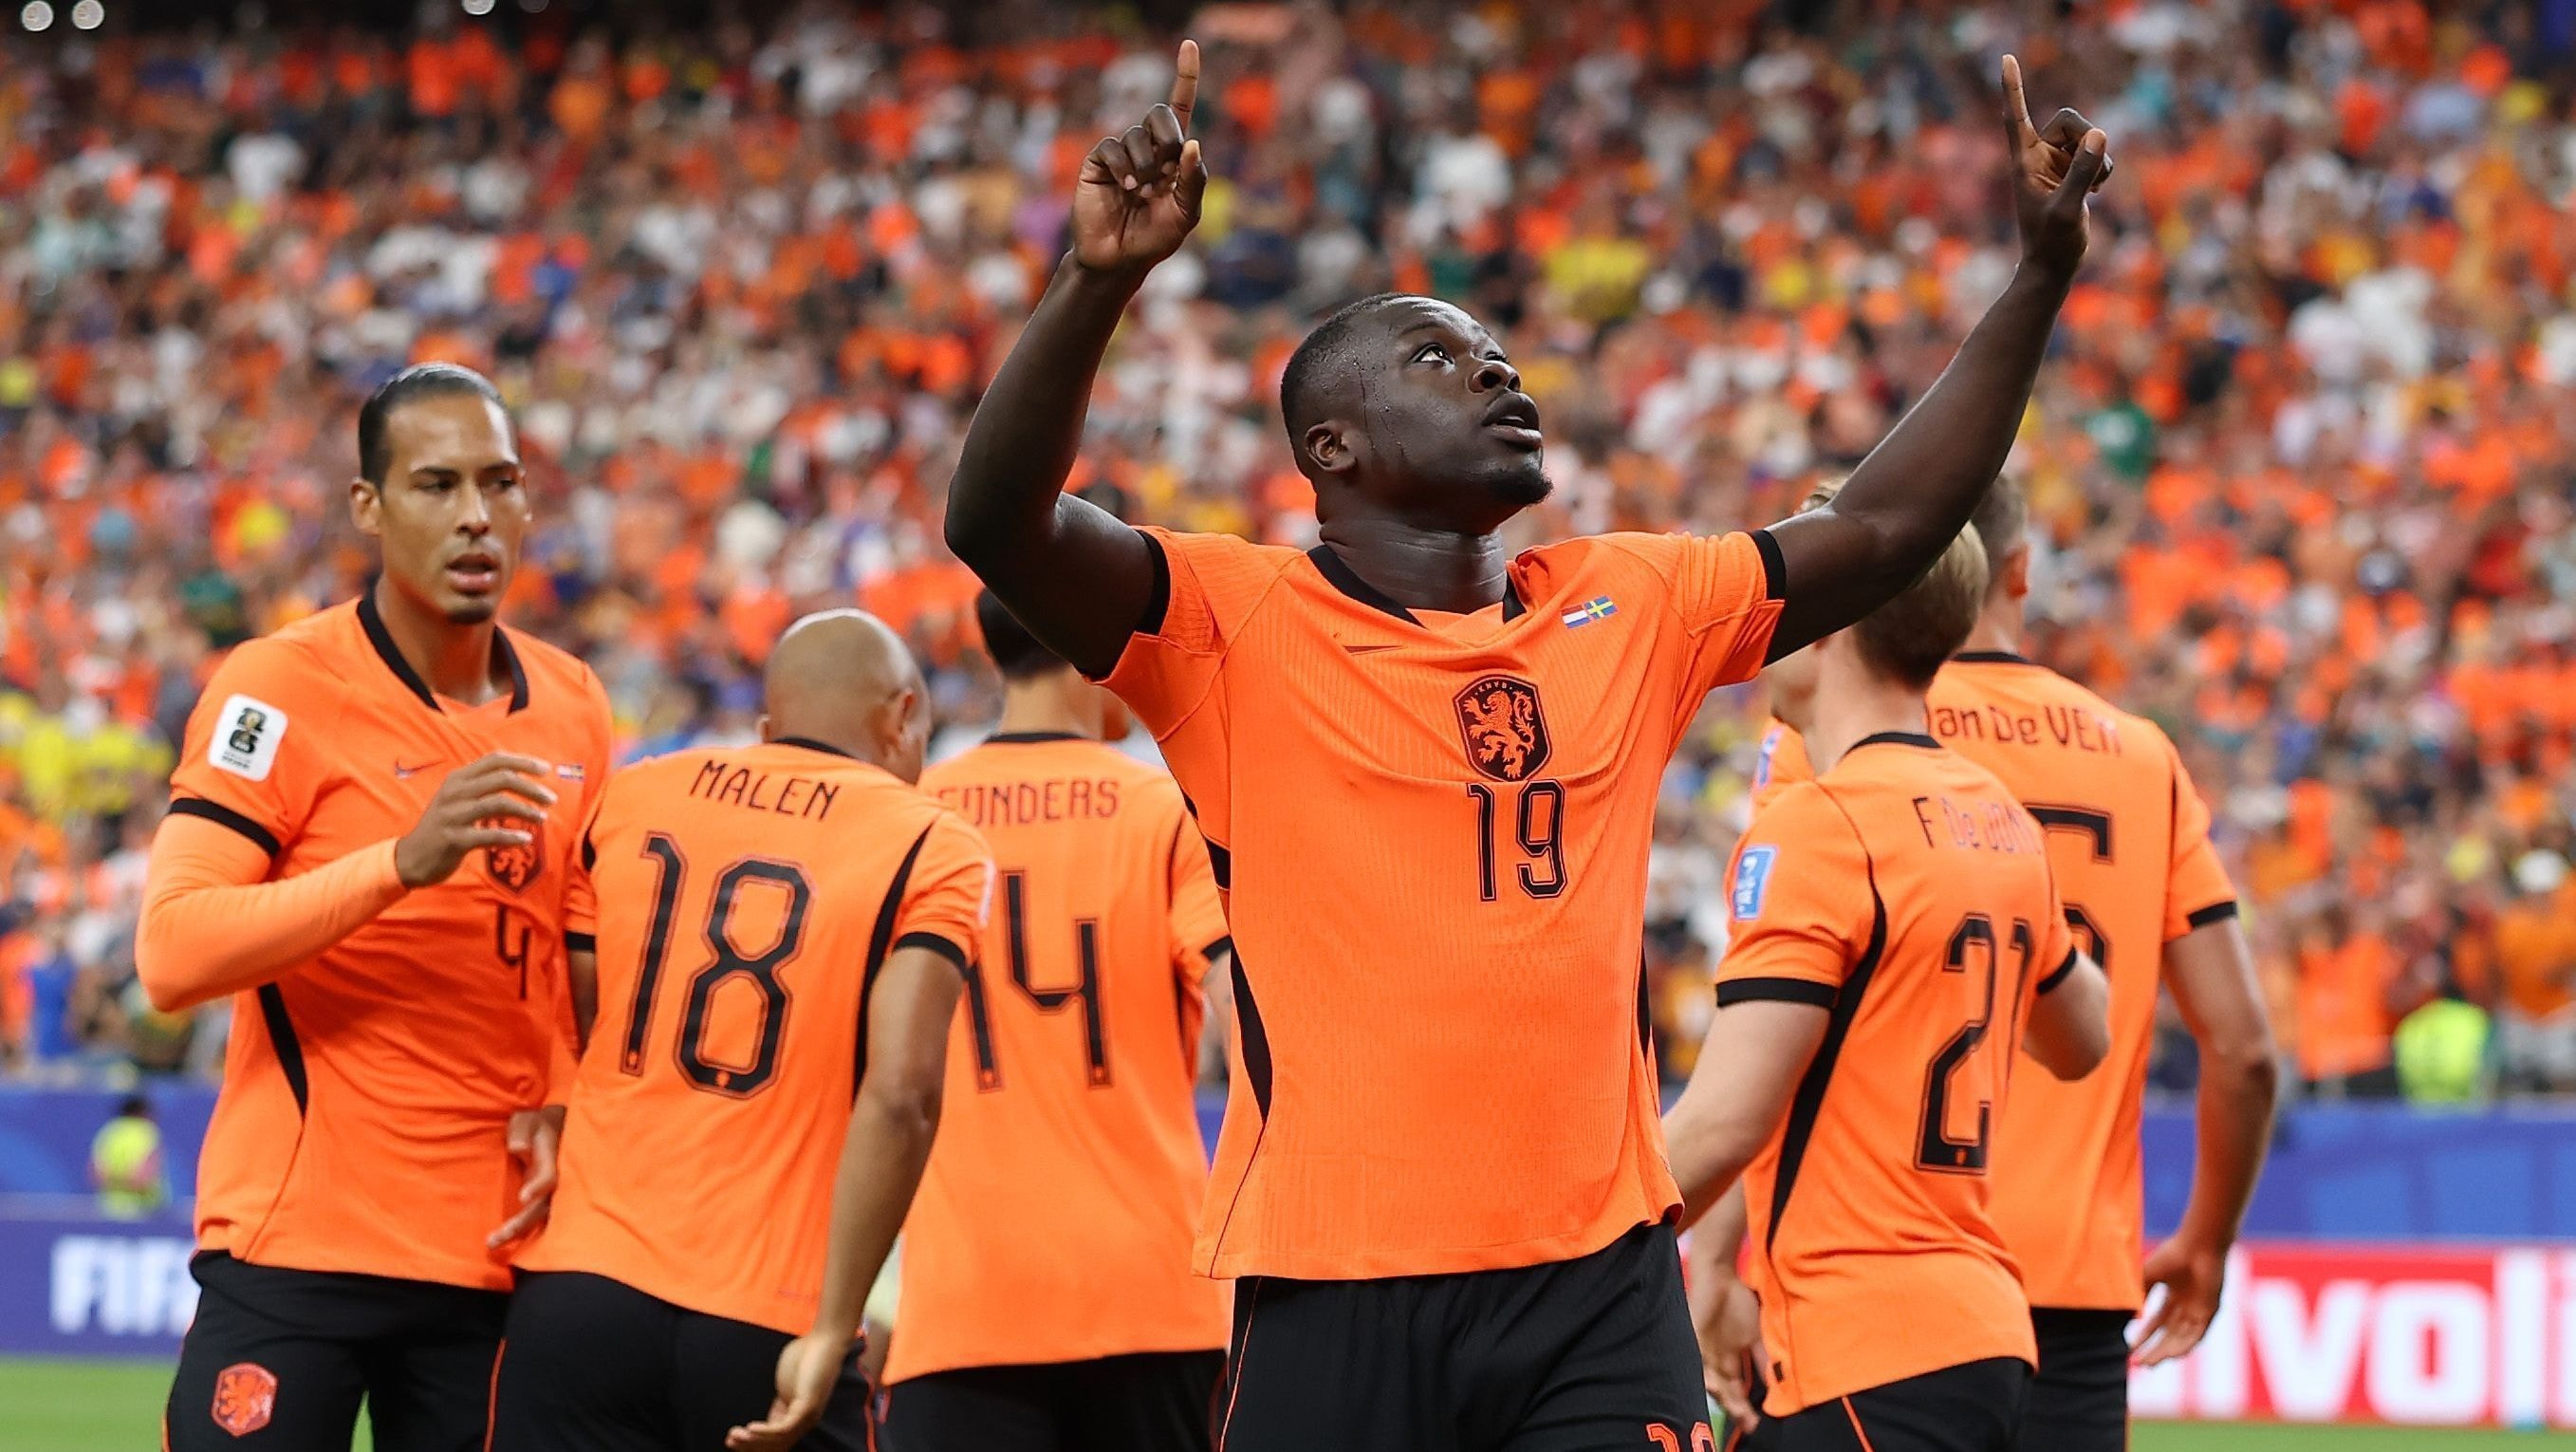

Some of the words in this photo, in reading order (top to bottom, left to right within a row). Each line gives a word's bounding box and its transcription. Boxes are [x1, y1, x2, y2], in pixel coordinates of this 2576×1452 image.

[689, 759, 842, 822] MALEN
[1466, 778, 1568, 903] 19
[1912, 796, 1935, 849] F
[495, 902, 532, 1003] 4
[620, 829, 820, 1101] 18
[961, 868, 1115, 1094] 14
[1914, 911, 2037, 1176] 21
